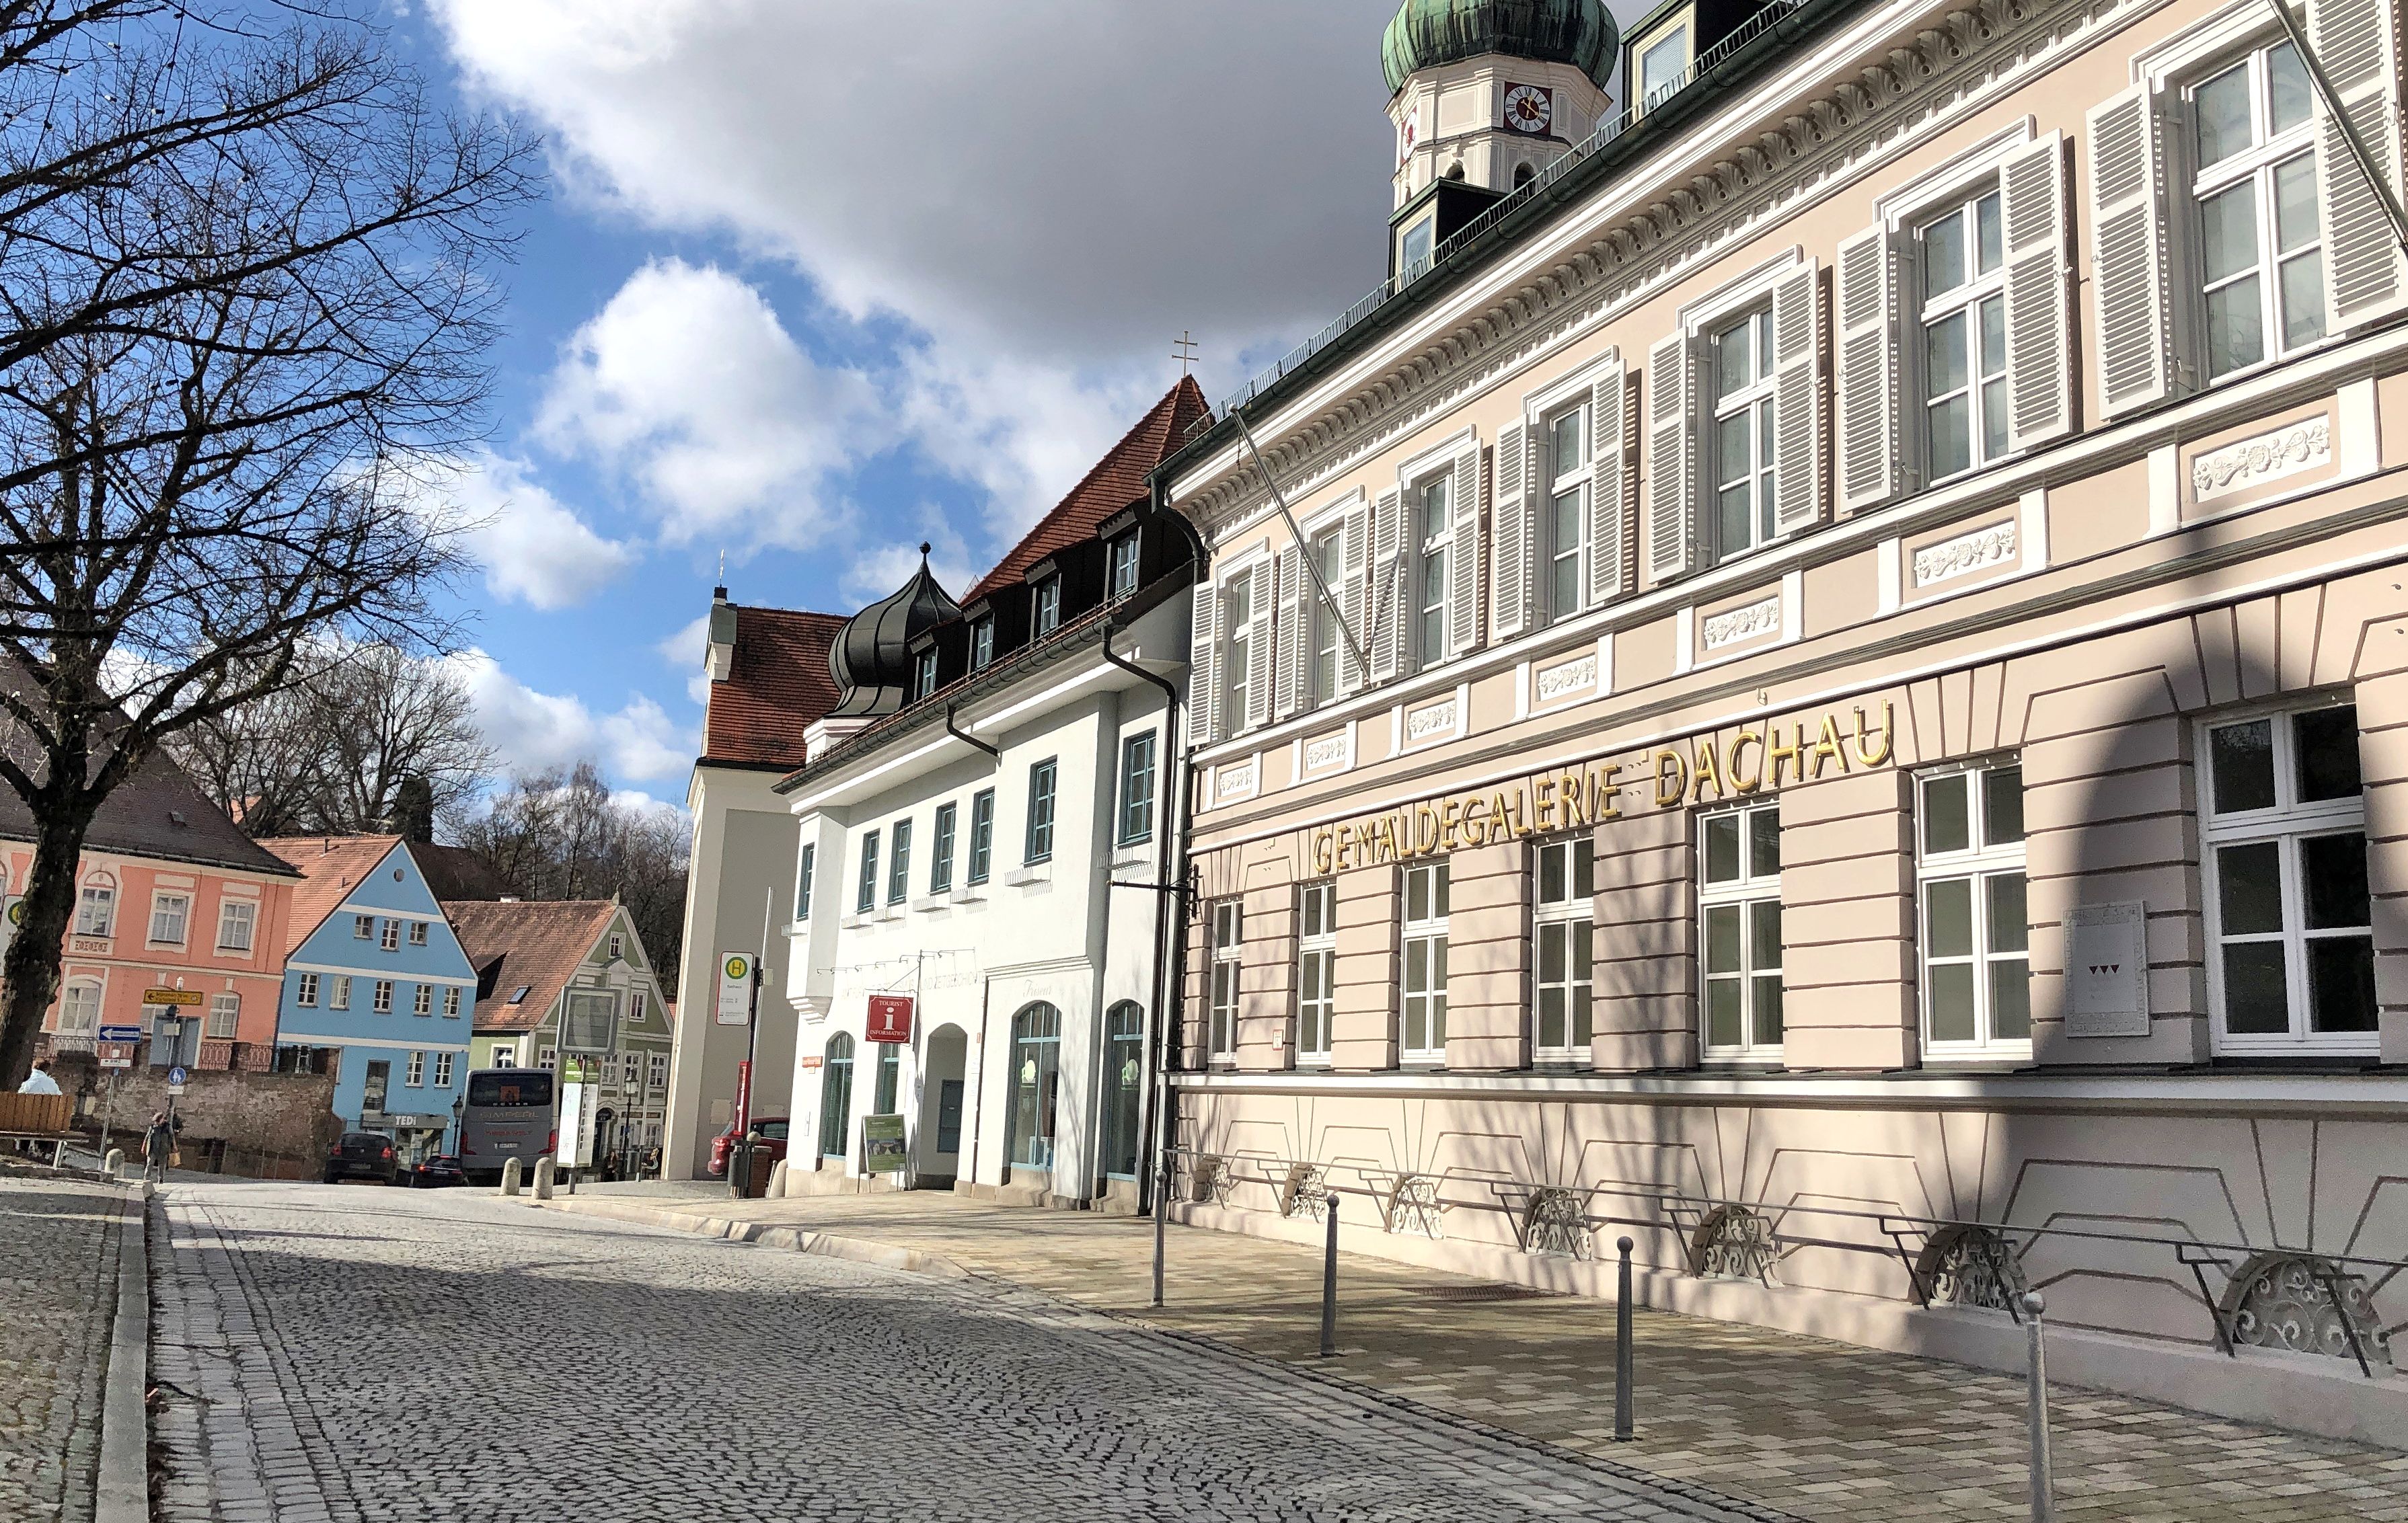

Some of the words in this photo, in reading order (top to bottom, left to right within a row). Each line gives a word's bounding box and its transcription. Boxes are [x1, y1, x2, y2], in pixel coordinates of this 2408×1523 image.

[1312, 763, 1622, 875] GEMÄLDEGALERIE
[1655, 699, 1894, 807] DACHAU
[732, 962, 742, 975] H
[480, 1110, 539, 1118] SIMPERL
